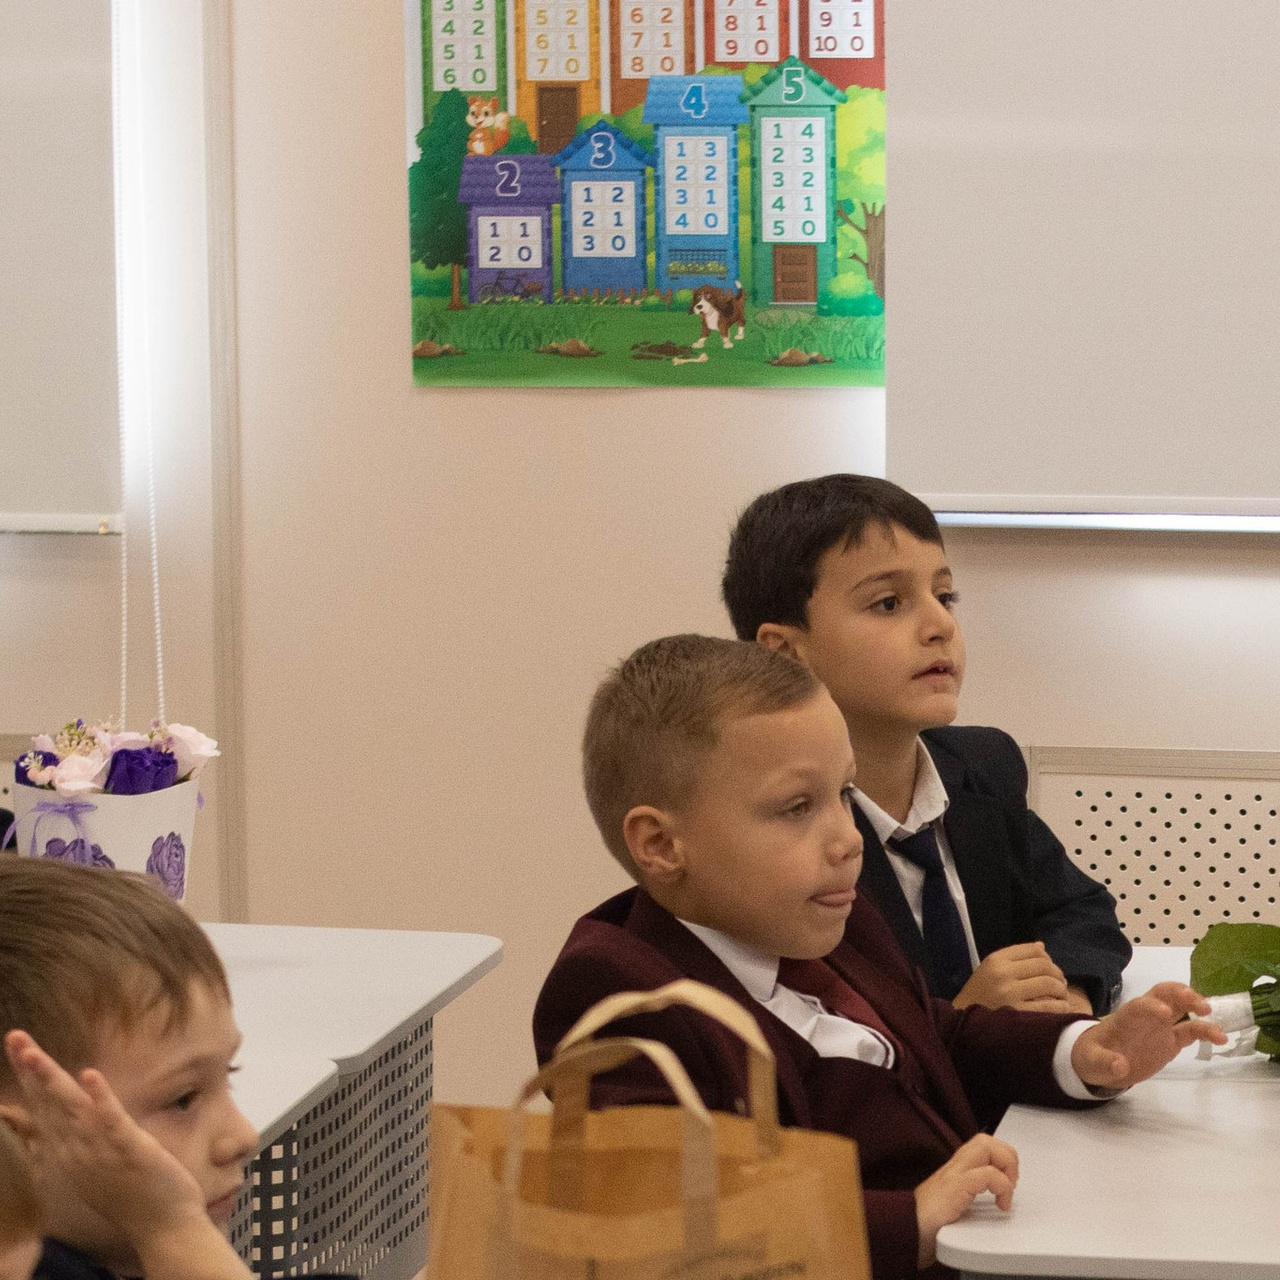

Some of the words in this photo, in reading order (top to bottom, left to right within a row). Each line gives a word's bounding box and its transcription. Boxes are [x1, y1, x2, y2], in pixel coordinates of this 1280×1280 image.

[536, 9, 548, 26] 5
[565, 9, 578, 26] 2
[630, 7, 644, 24] 6
[660, 7, 673, 24] 2
[724, 14, 739, 32] 8
[756, 15, 767, 32] 1
[819, 10, 833, 28] 9
[852, 11, 862, 28] 1
[441, 19, 456, 36] 4
[472, 19, 485, 36] 2
[536, 33, 549, 50] 6
[567, 33, 578, 50] 1
[631, 31, 644, 48] 7
[662, 32, 673, 48] 1
[724, 39, 739, 56] 9
[754, 39, 769, 56] 0
[814, 35, 838, 53] 10
[850, 35, 864, 52] 0
[443, 43, 456, 60] 5
[474, 43, 485, 60] 1
[536, 58, 549, 74] 7
[565, 57, 580, 74] 0
[631, 55, 644, 73] 8
[660, 56, 675, 73] 0
[443, 68, 456, 85] 6
[472, 67, 487, 85] 0
[782, 67, 805, 103] 5
[680, 83, 708, 118] 4
[773, 122, 784, 139] 1
[800, 122, 815, 139] 4
[589, 133, 616, 168] 3
[676, 141, 687, 158] 1
[705, 141, 717, 158] 3
[771, 146, 784, 164] 2
[802, 146, 814, 164] 3
[495, 160, 521, 196] 2
[675, 164, 688, 182] 2
[704, 164, 717, 182] 2
[772, 170, 785, 188] 3
[801, 171, 814, 188] 2
[582, 186, 593, 203] 1
[611, 186, 624, 203] 2
[676, 188, 688, 206] 3
[706, 188, 717, 205] 1
[771, 195, 786, 212] 4
[803, 195, 814, 212] 1
[582, 210, 595, 228] 2
[614, 210, 624, 228] 1
[674, 212, 689, 229] 4
[703, 212, 719, 229] 0
[773, 219, 786, 237] 5
[801, 219, 816, 237] 0
[489, 221, 500, 238] 1
[519, 222, 530, 238] 1
[583, 234, 595, 252] 3
[610, 234, 626, 252] 0
[489, 245, 501, 262] 2
[517, 245, 532, 262] 0
